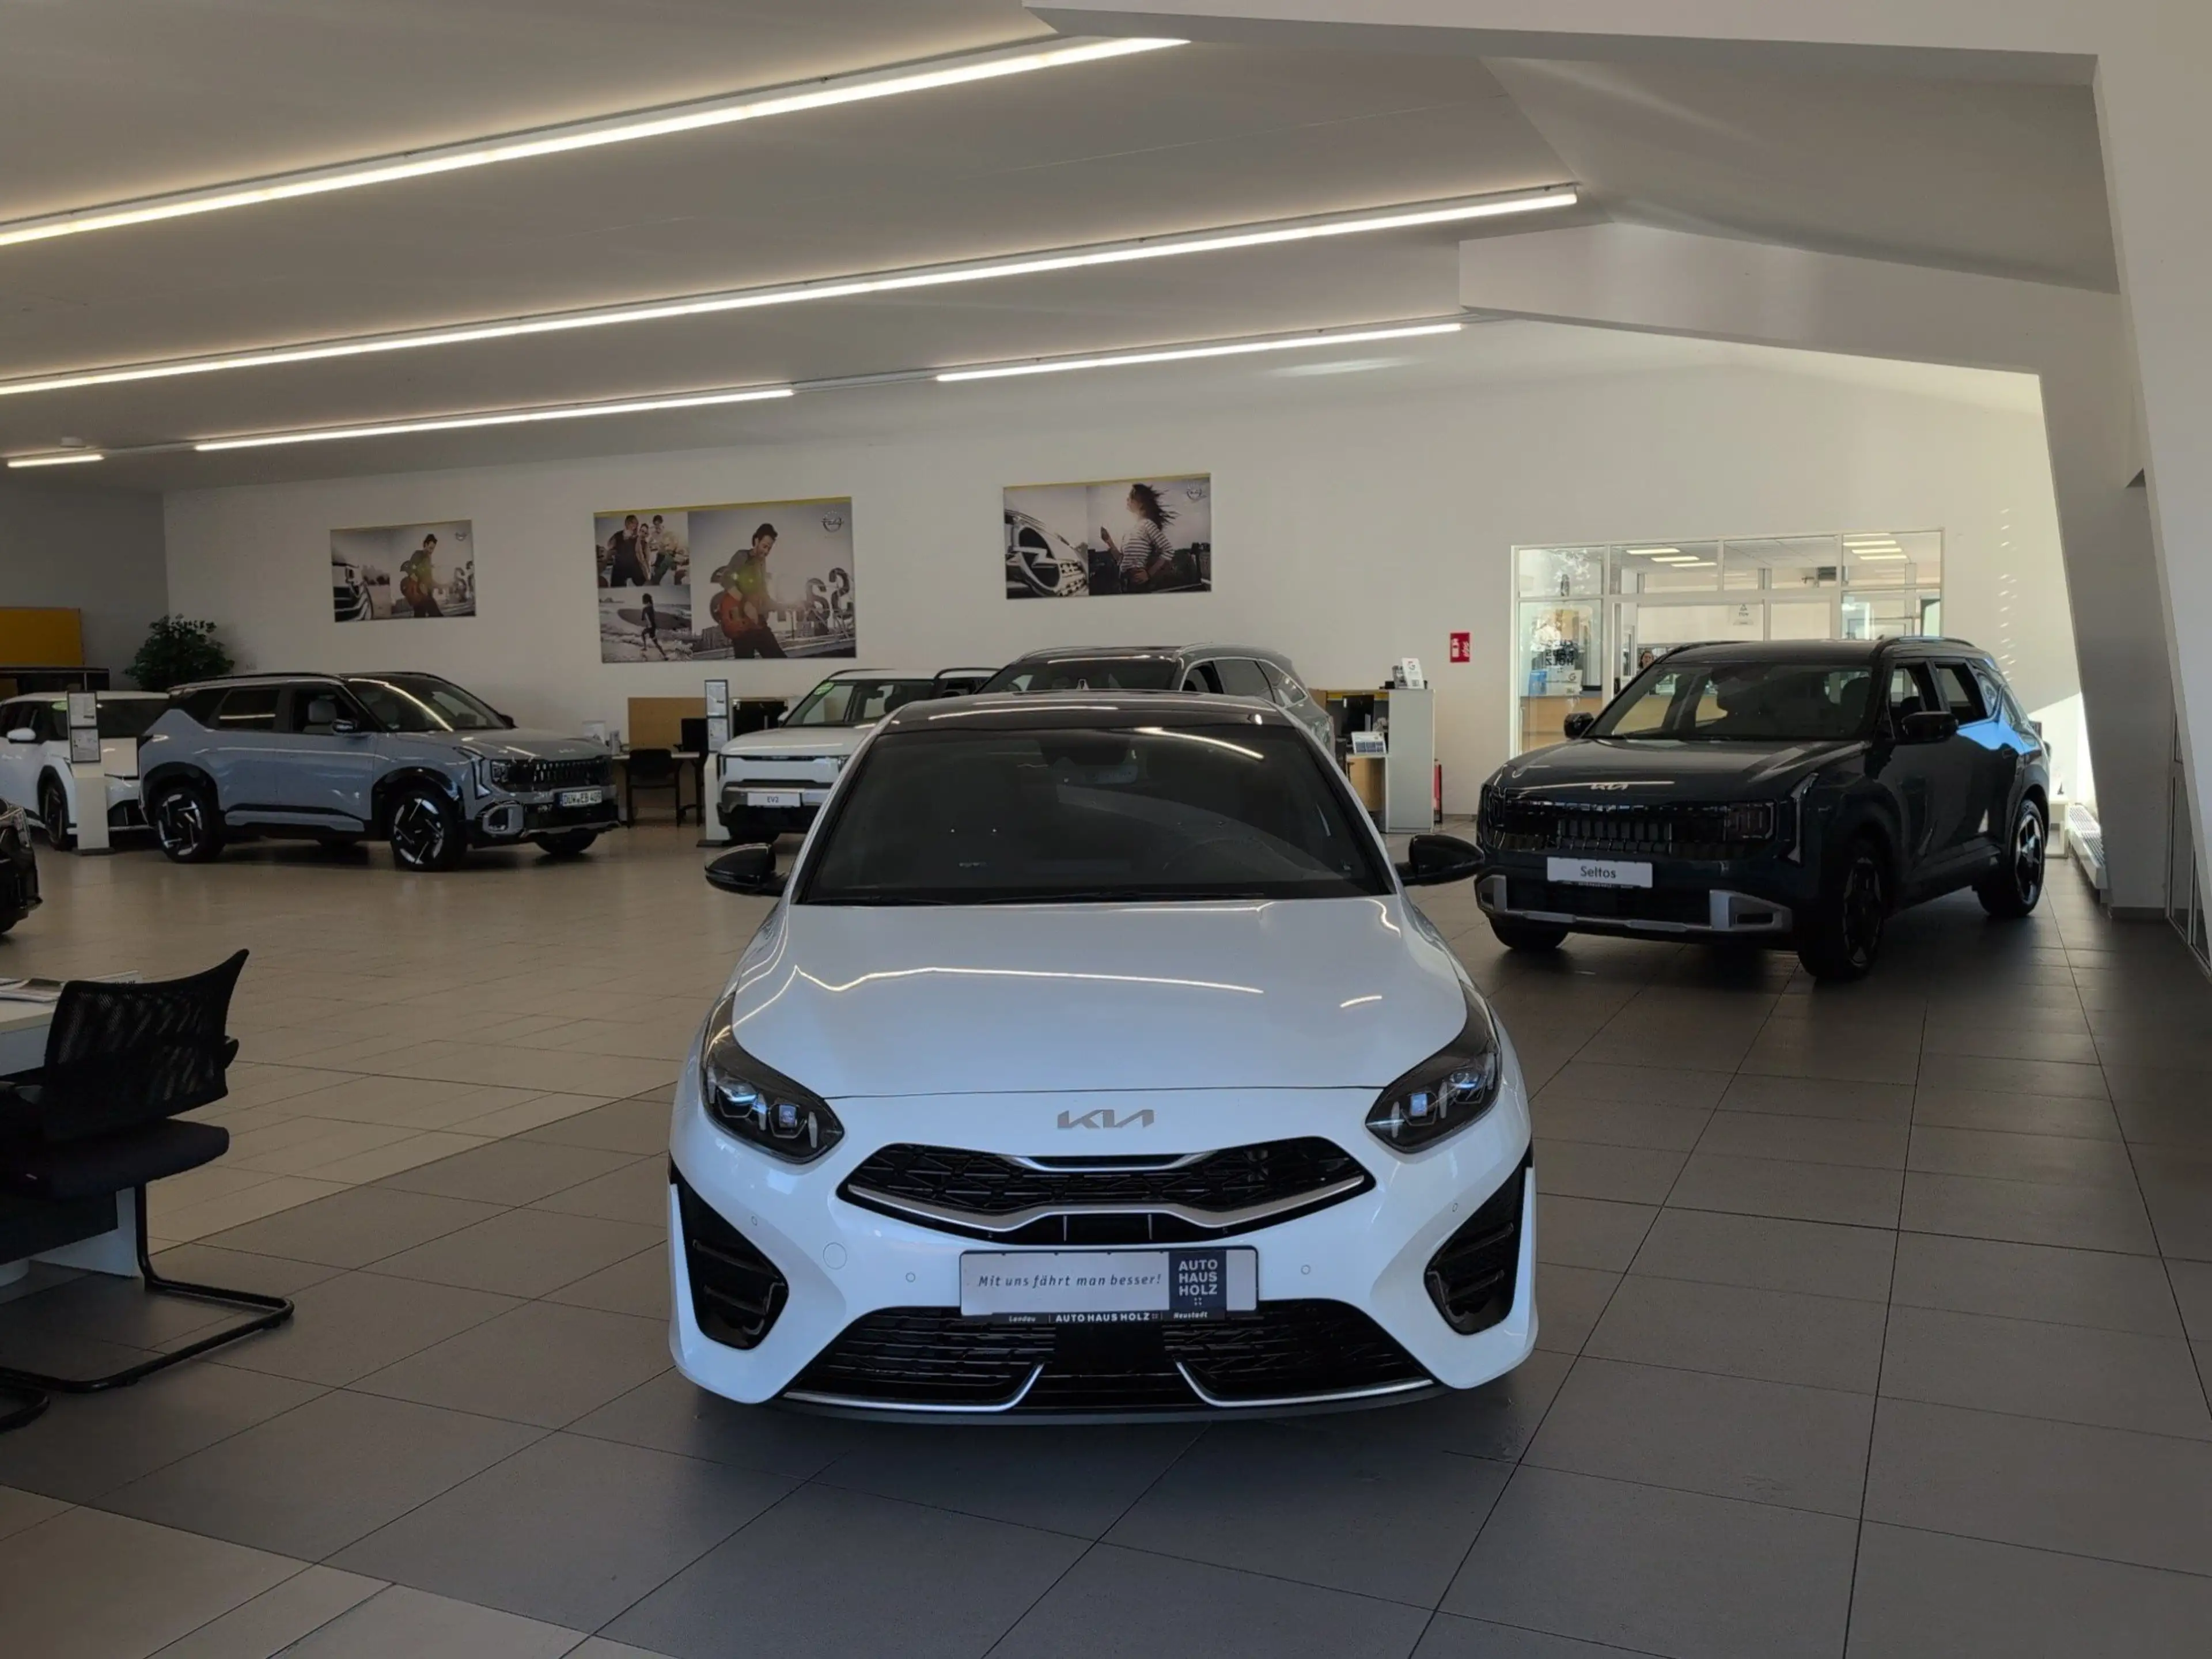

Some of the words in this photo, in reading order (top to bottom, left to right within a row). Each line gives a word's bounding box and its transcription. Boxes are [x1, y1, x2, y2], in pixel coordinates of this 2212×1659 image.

[1580, 866, 1616, 879] Seltos
[1058, 1109, 1154, 1129] KIA
[1179, 1259, 1218, 1271] AUTO
[978, 1275, 1001, 1287] Mit
[1005, 1277, 1029, 1287] uns
[1032, 1274, 1070, 1289] fährt
[1077, 1277, 1105, 1287] man
[1110, 1274, 1162, 1286] besser!
[1179, 1271, 1218, 1283] HAUS
[1179, 1283, 1217, 1296] HOLZ
[1055, 1314, 1085, 1323] AUTO
[1087, 1313, 1118, 1323] HAUS
[1120, 1312, 1150, 1322] HOLZ
